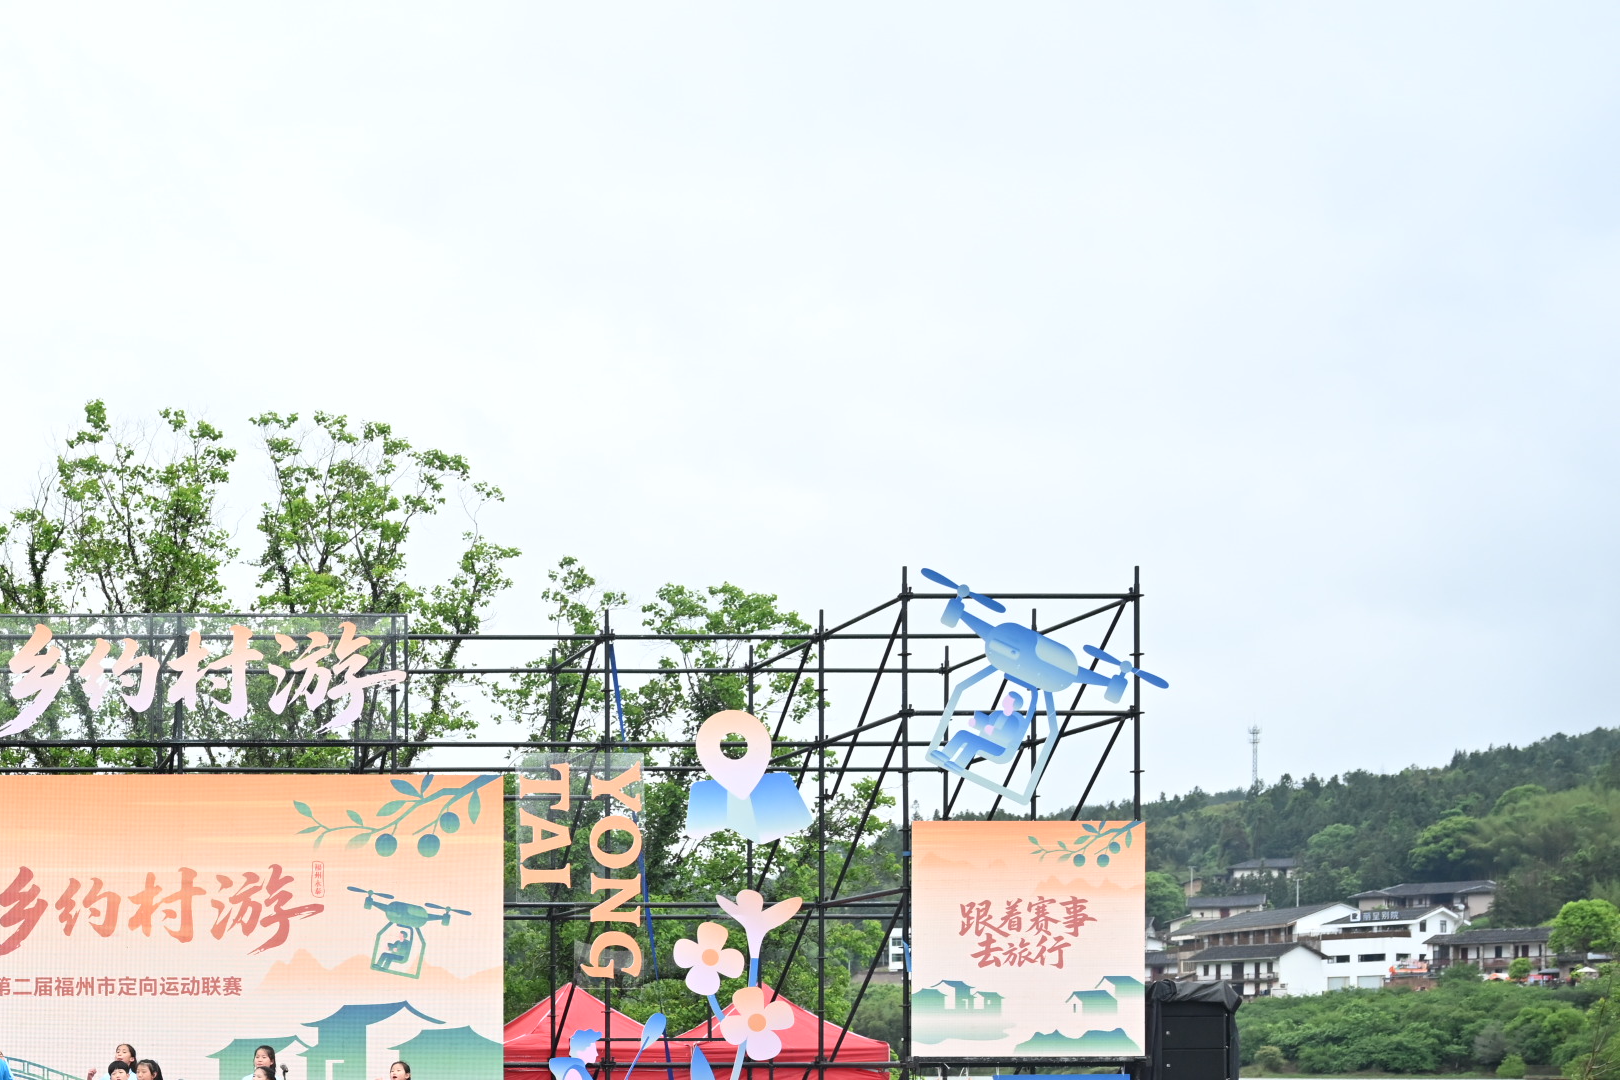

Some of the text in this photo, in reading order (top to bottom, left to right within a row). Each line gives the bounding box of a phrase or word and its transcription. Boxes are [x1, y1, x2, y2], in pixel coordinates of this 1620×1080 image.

[519, 761, 572, 892] TAI
[581, 760, 643, 981] YONG
[958, 895, 1098, 938] 跟着赛事
[970, 932, 1072, 969] 去旅行
